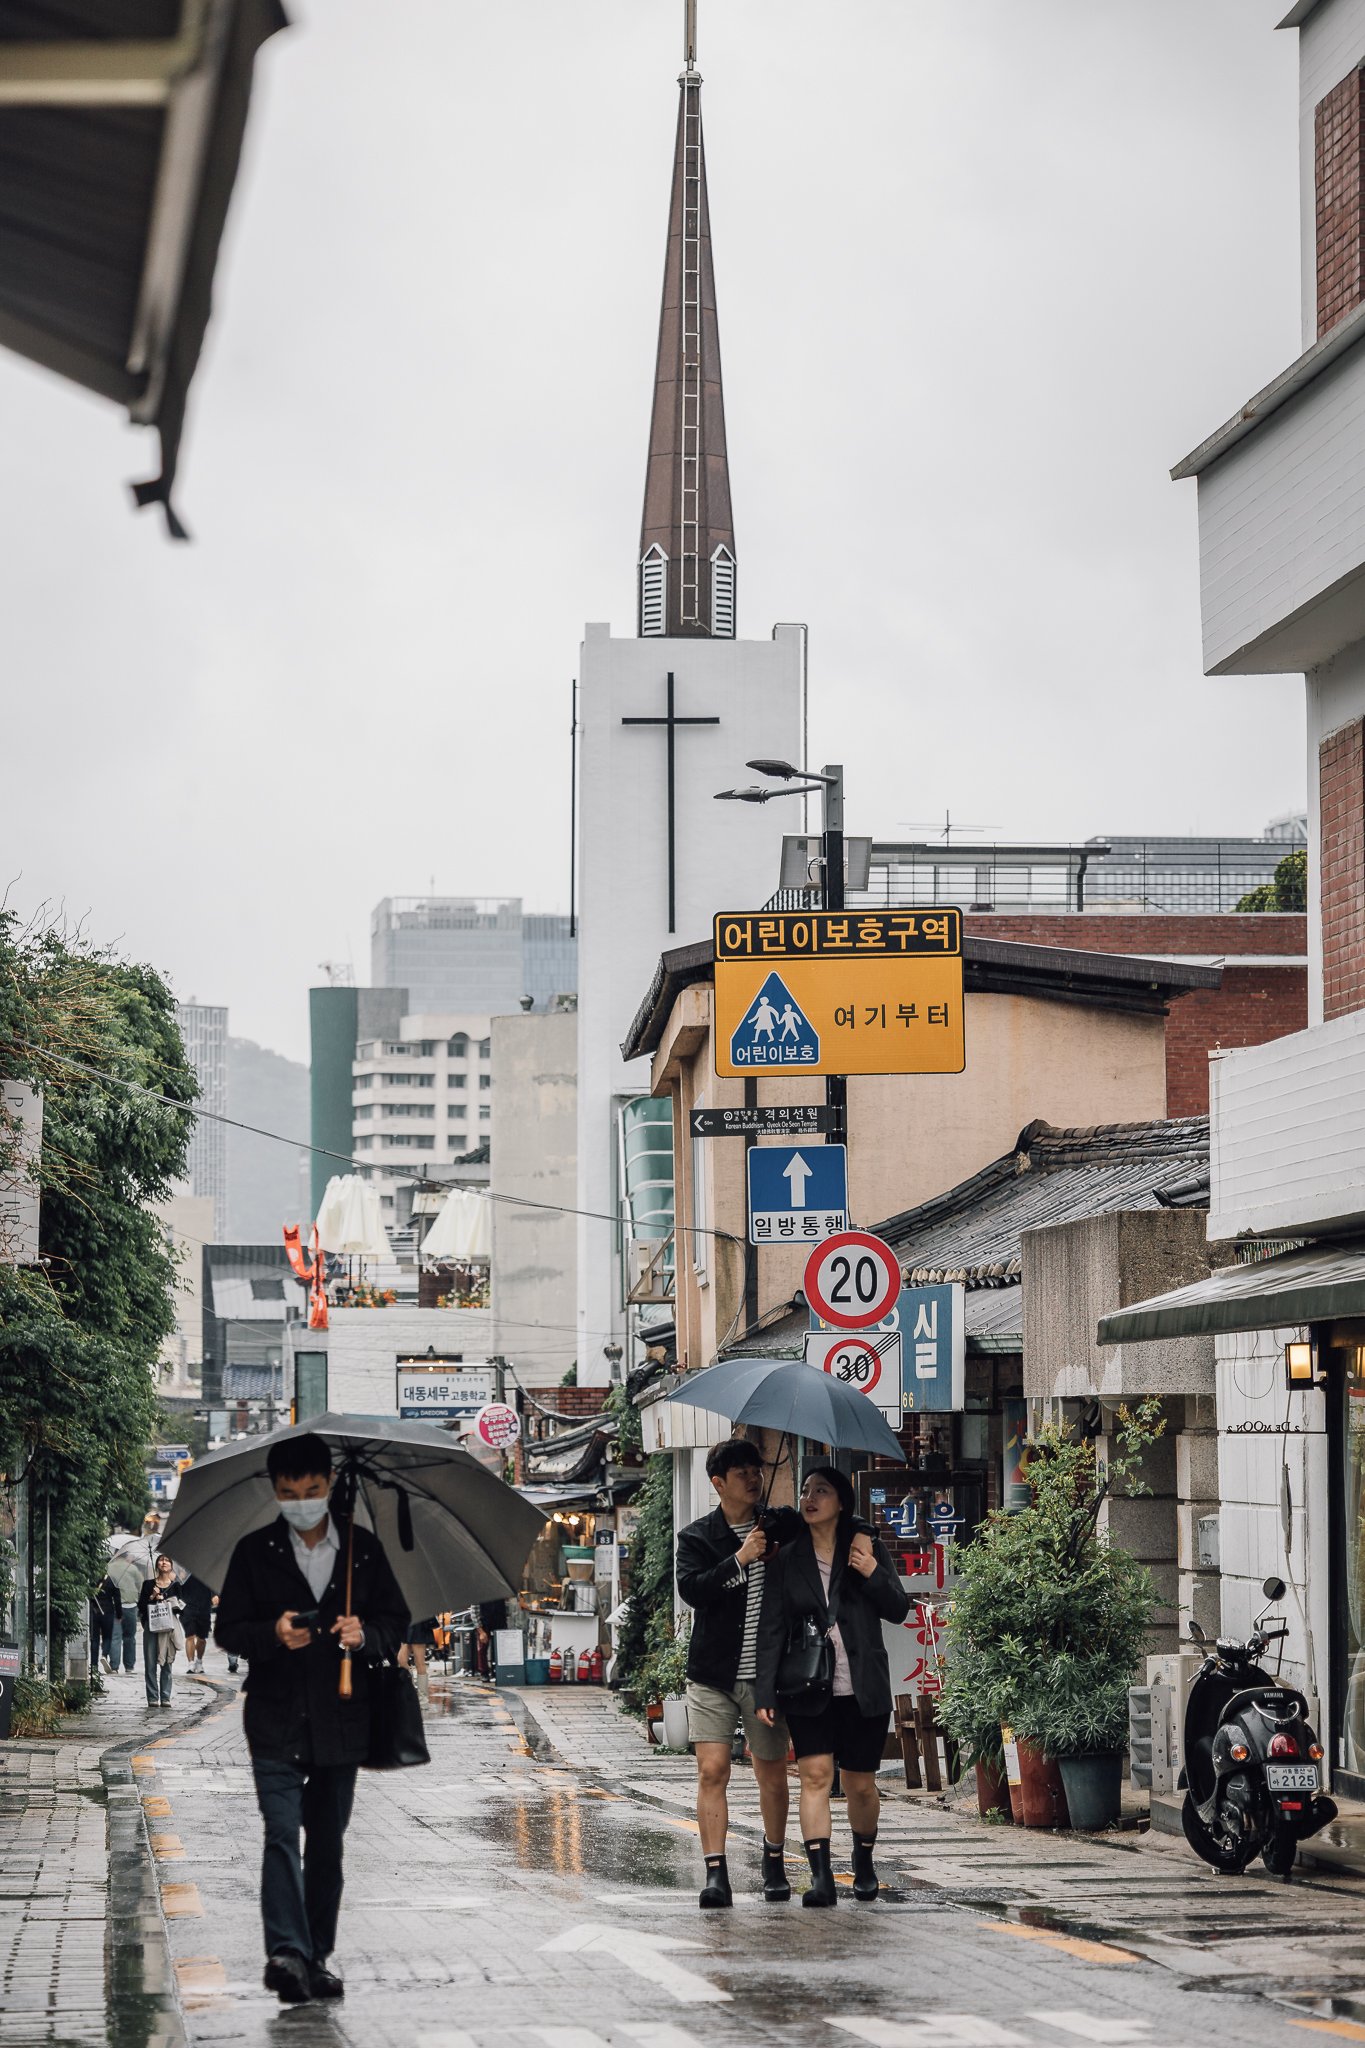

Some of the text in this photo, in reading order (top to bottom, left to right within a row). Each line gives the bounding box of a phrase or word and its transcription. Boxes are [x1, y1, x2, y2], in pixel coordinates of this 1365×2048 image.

[724, 915, 949, 953] 어린이보호구역
[834, 1003, 949, 1029] 여기부터
[736, 1044, 815, 1063] 어린이보호
[754, 1214, 844, 1237] 일방통행
[830, 1256, 877, 1304] 20
[836, 1354, 870, 1382] 30
[403, 1386, 487, 1402] 대동세무 고등학교
[600, 1536, 610, 1544] 83
[1282, 1775, 1315, 1787] 2125
